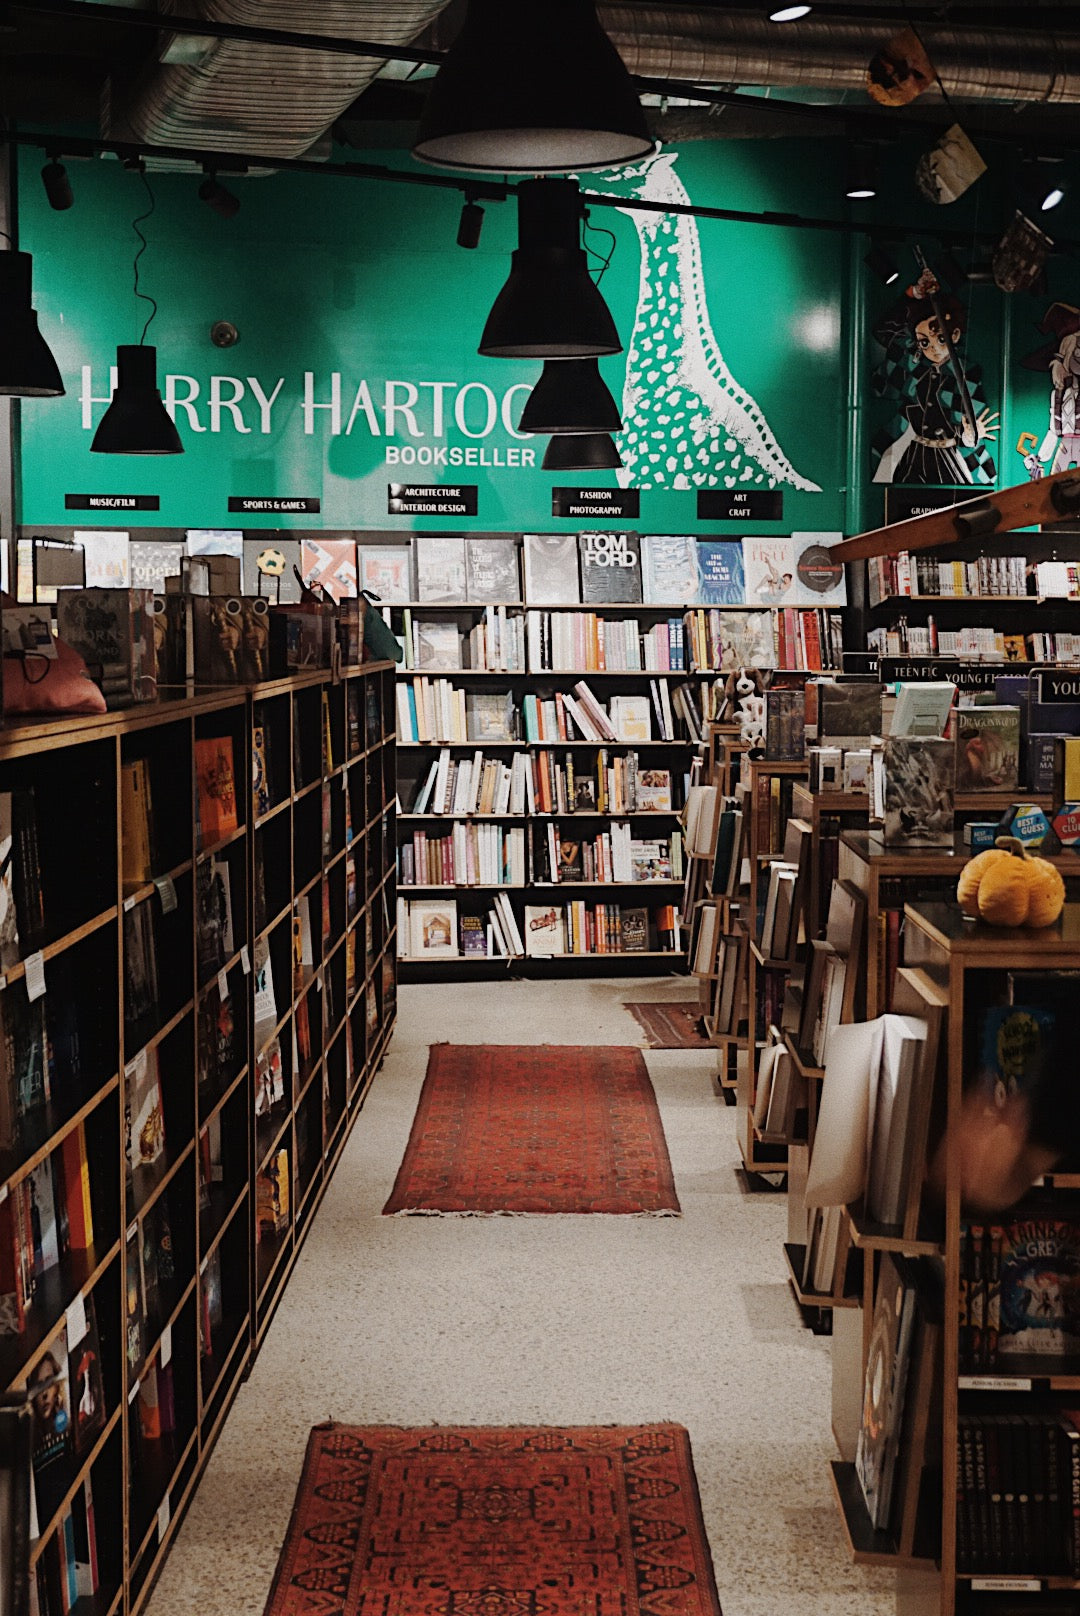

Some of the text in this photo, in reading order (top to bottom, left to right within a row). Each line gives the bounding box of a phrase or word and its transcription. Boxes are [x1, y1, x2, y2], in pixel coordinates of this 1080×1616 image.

[78, 365, 285, 434] HRRY
[385, 445, 536, 467] BOOKSELLER
[404, 488, 461, 497] ARCHITECTURE
[580, 491, 612, 500] FASHION
[733, 494, 748, 502] ART
[89, 497, 136, 507] MUSIC/FILM
[242, 499, 306, 510] SPORTS & GAMES
[400, 503, 466, 513] INTERIOR DESIGN
[569, 506, 622, 515] PHOTOGRAPHY
[728, 508, 751, 517] CRAFT
[583, 534, 628, 550] TOM
[585, 551, 638, 567] FORD
[895, 667, 919, 677] TEEN
[945, 673, 981, 684] YOUNG
[1017, 817, 1034, 828] BEST
[1021, 823, 1045, 835] GUESS
[1026, 1240, 1063, 1257] GREY
